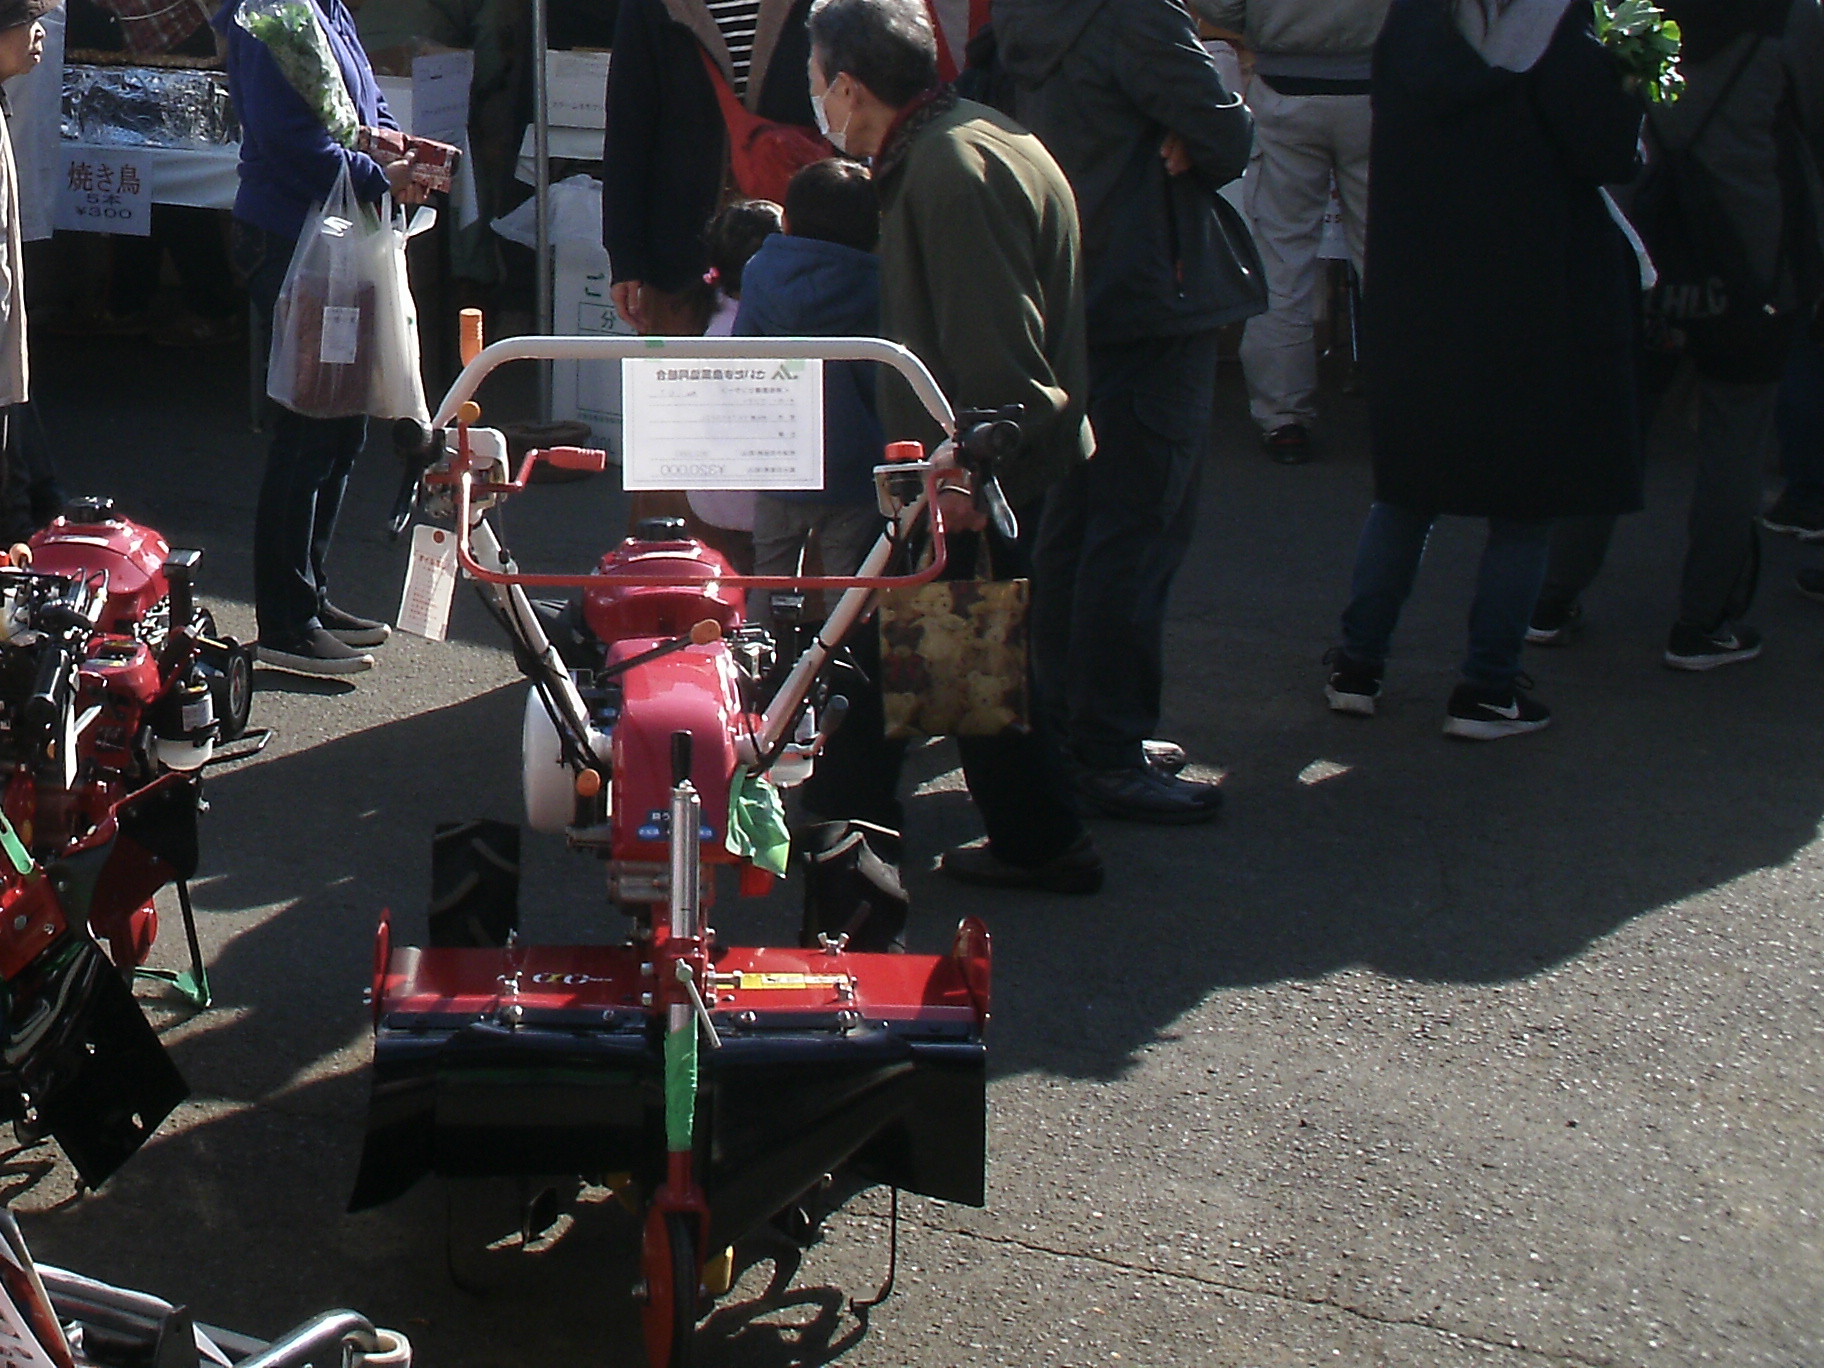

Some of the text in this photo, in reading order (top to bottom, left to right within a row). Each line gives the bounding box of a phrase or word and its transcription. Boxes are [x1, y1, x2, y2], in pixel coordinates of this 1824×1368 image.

[68, 161, 140, 194] 焼き鳥
[76, 207, 132, 219] ¥300
